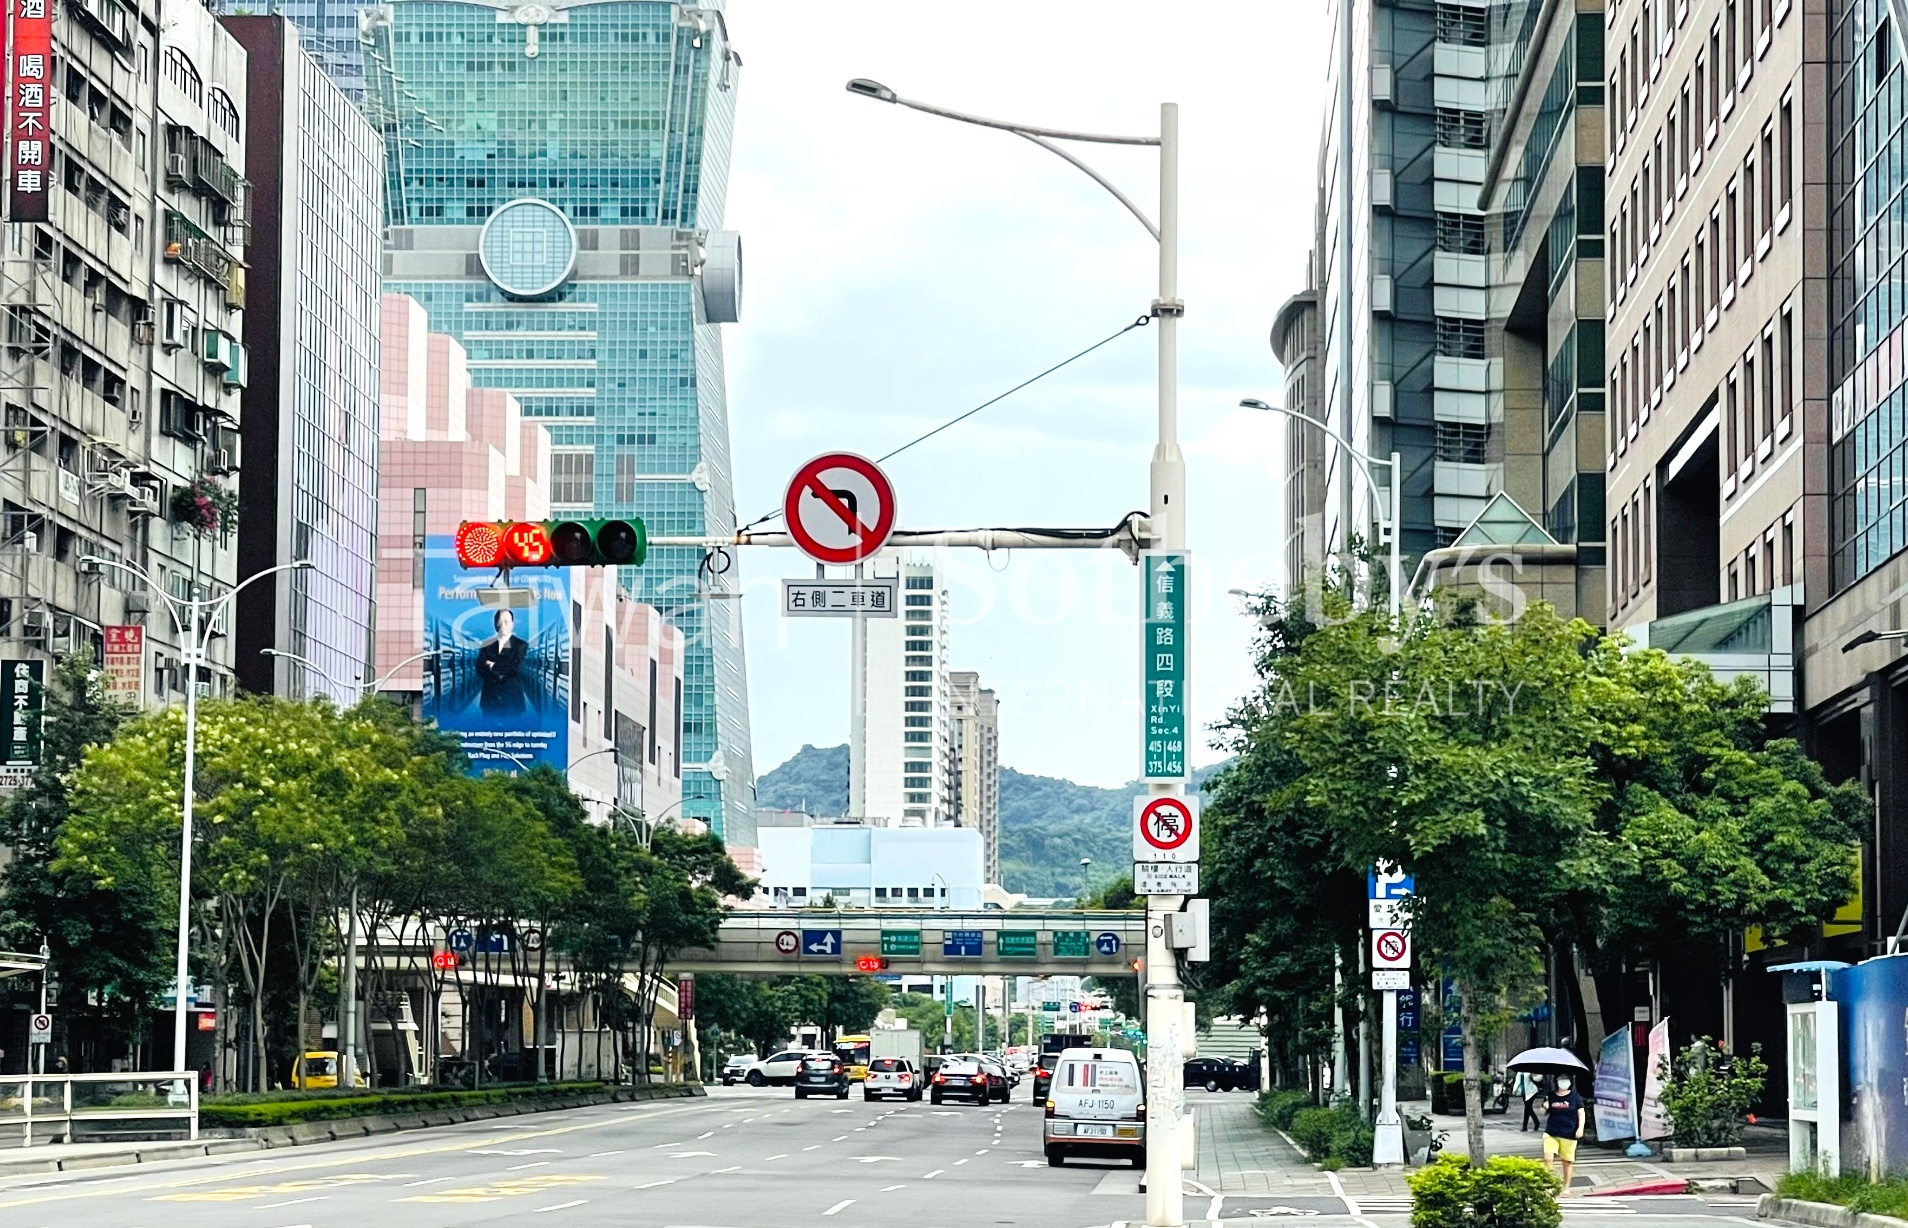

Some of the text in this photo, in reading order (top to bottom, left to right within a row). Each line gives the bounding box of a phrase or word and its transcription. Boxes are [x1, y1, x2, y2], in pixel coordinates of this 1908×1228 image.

[16, 54, 44, 194] 喝酒不開車
[513, 529, 544, 561] 45
[791, 590, 886, 608] 右側二車道
[1155, 574, 1174, 698] 信義路四段
[1150, 704, 1180, 713] XinYi
[1150, 716, 1166, 724] Rd.
[1149, 740, 1182, 752] 415 468
[1148, 761, 1182, 773] 375 456
[1153, 812, 1179, 837] 停
[1079, 1099, 1115, 1110] AFJ-1150
